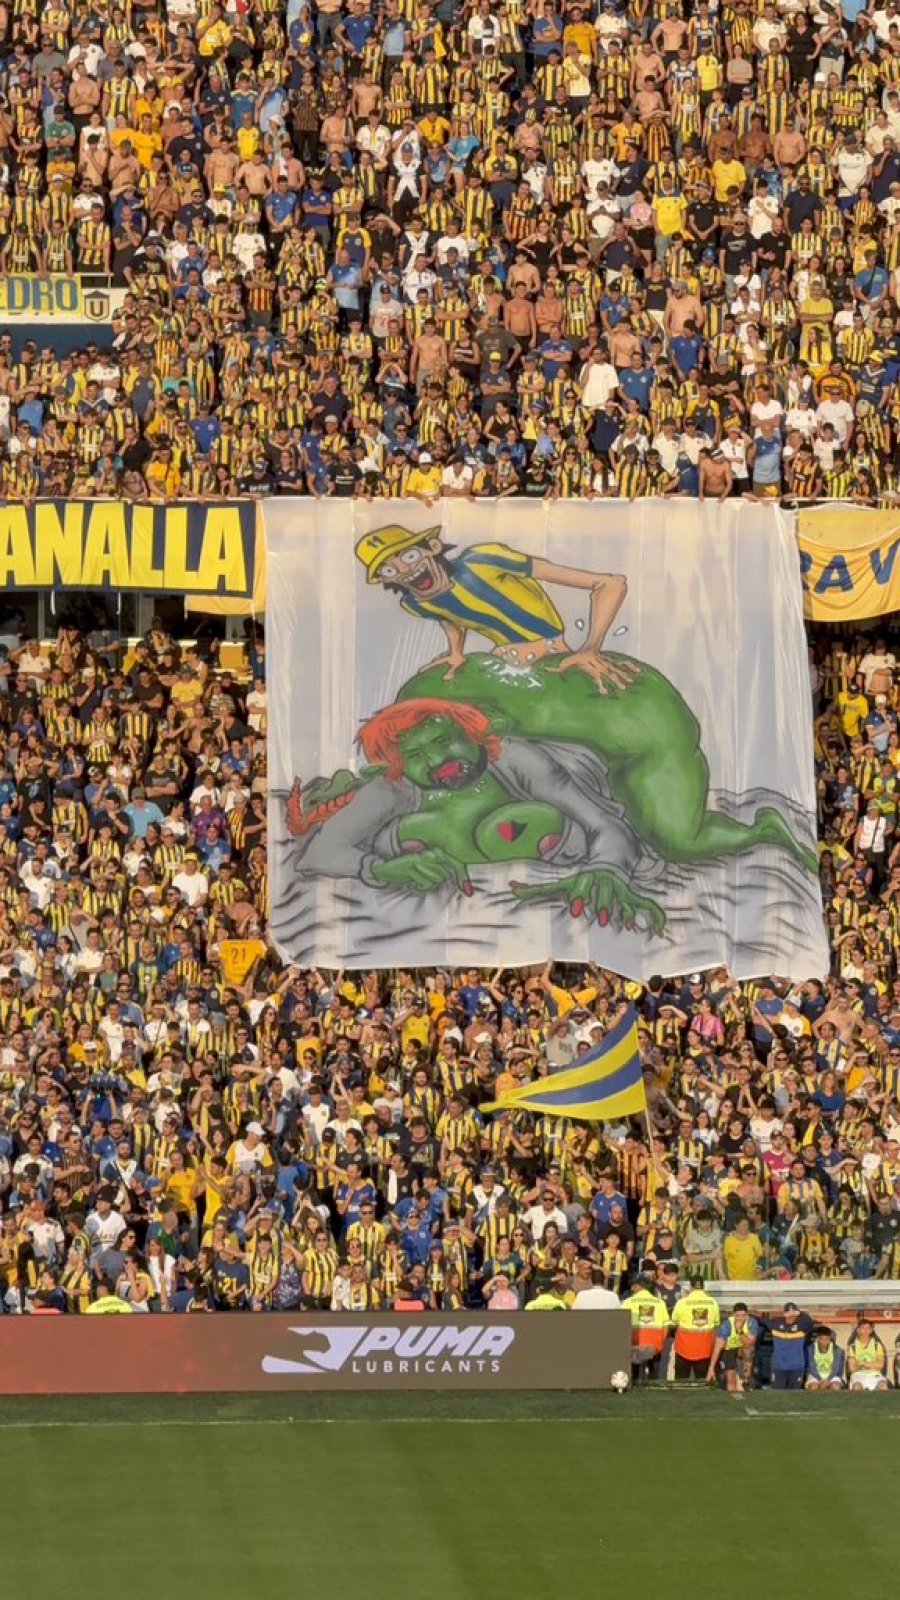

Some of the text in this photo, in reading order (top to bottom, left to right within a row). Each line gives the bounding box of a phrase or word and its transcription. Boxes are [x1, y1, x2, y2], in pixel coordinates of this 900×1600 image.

[0, 277, 78, 311] DRO
[0, 502, 247, 591] ANALLA
[353, 1326, 515, 1357] PUMA
[352, 1360, 501, 1373] LUBRICANTS
